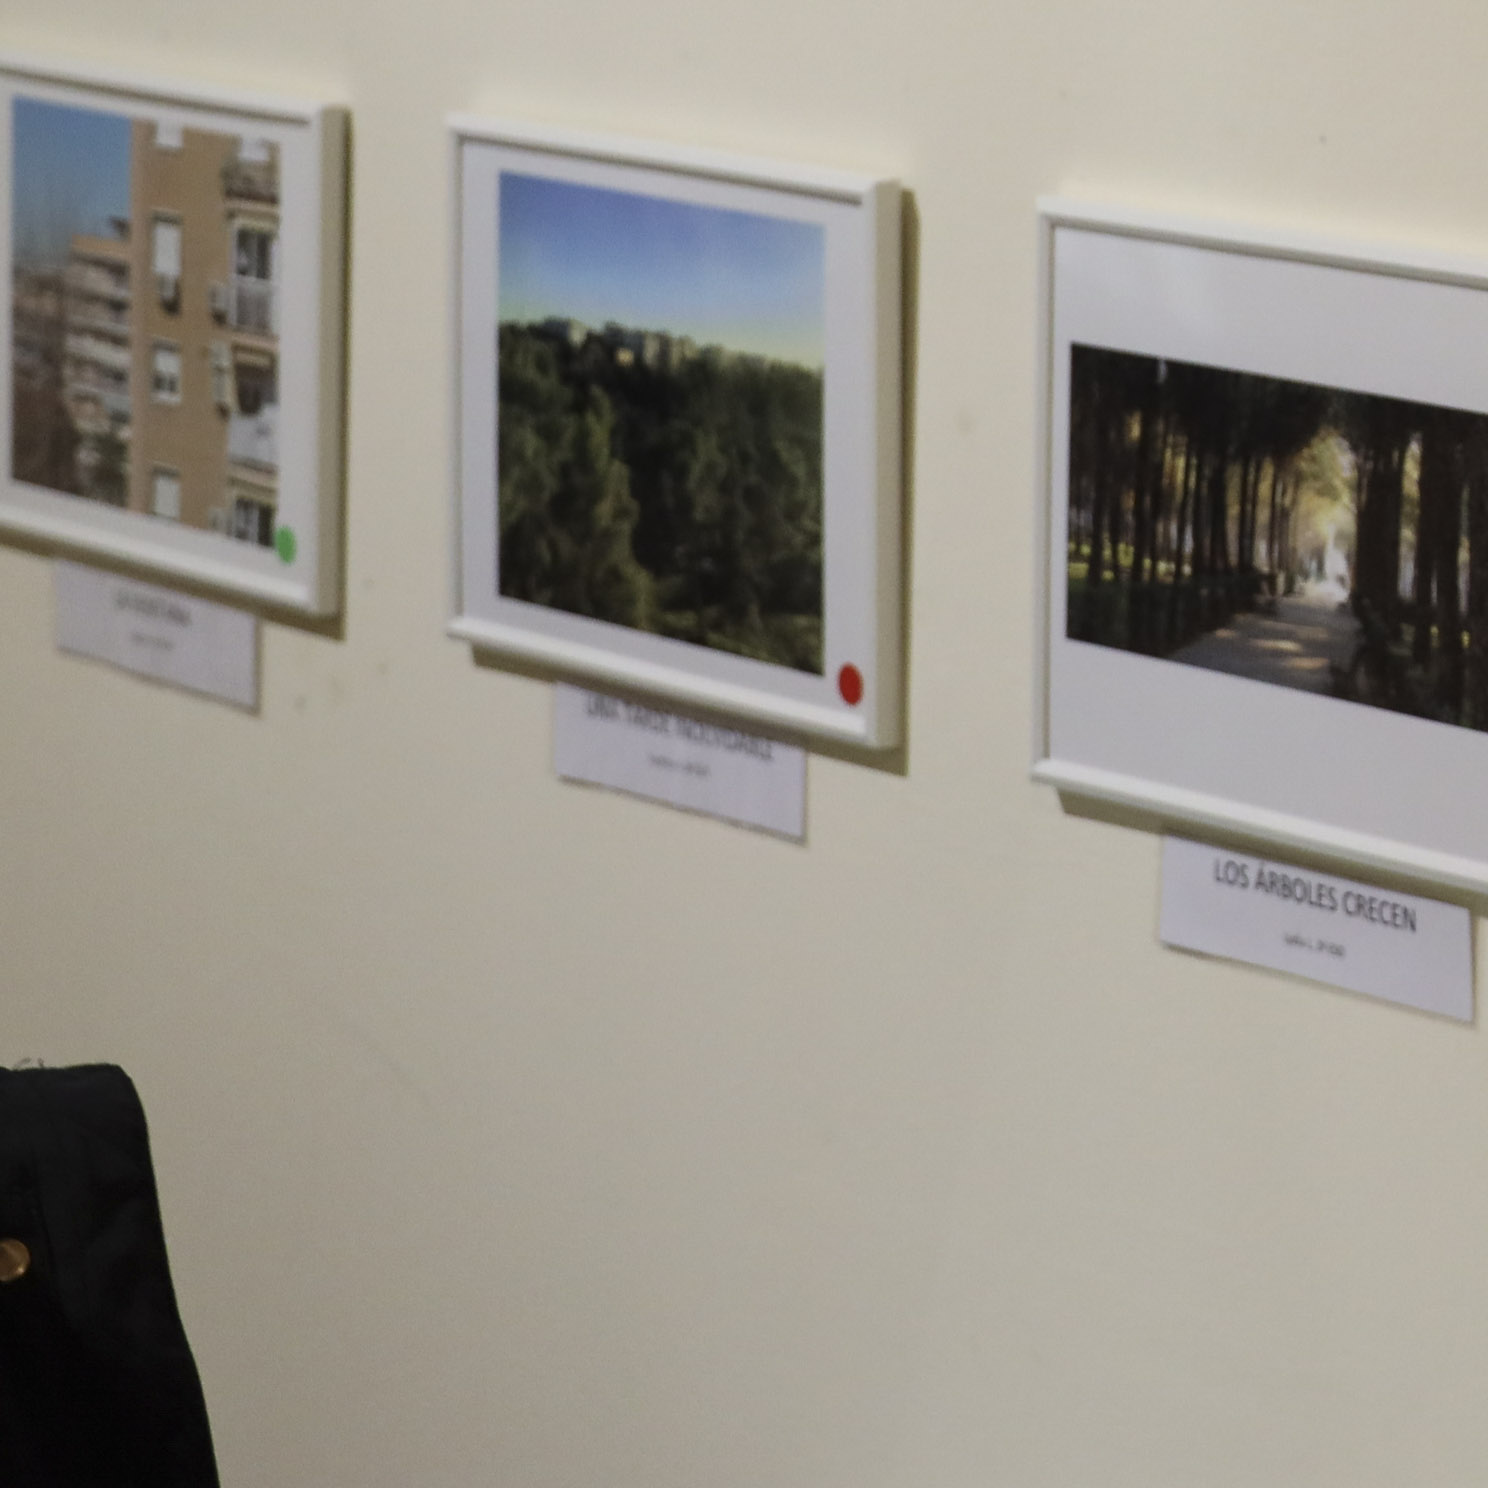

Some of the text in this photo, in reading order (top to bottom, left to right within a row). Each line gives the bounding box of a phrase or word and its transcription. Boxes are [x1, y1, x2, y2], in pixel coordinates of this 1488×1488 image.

[1213, 858, 1417, 933] LOS ÁRBOLES CRECEN
